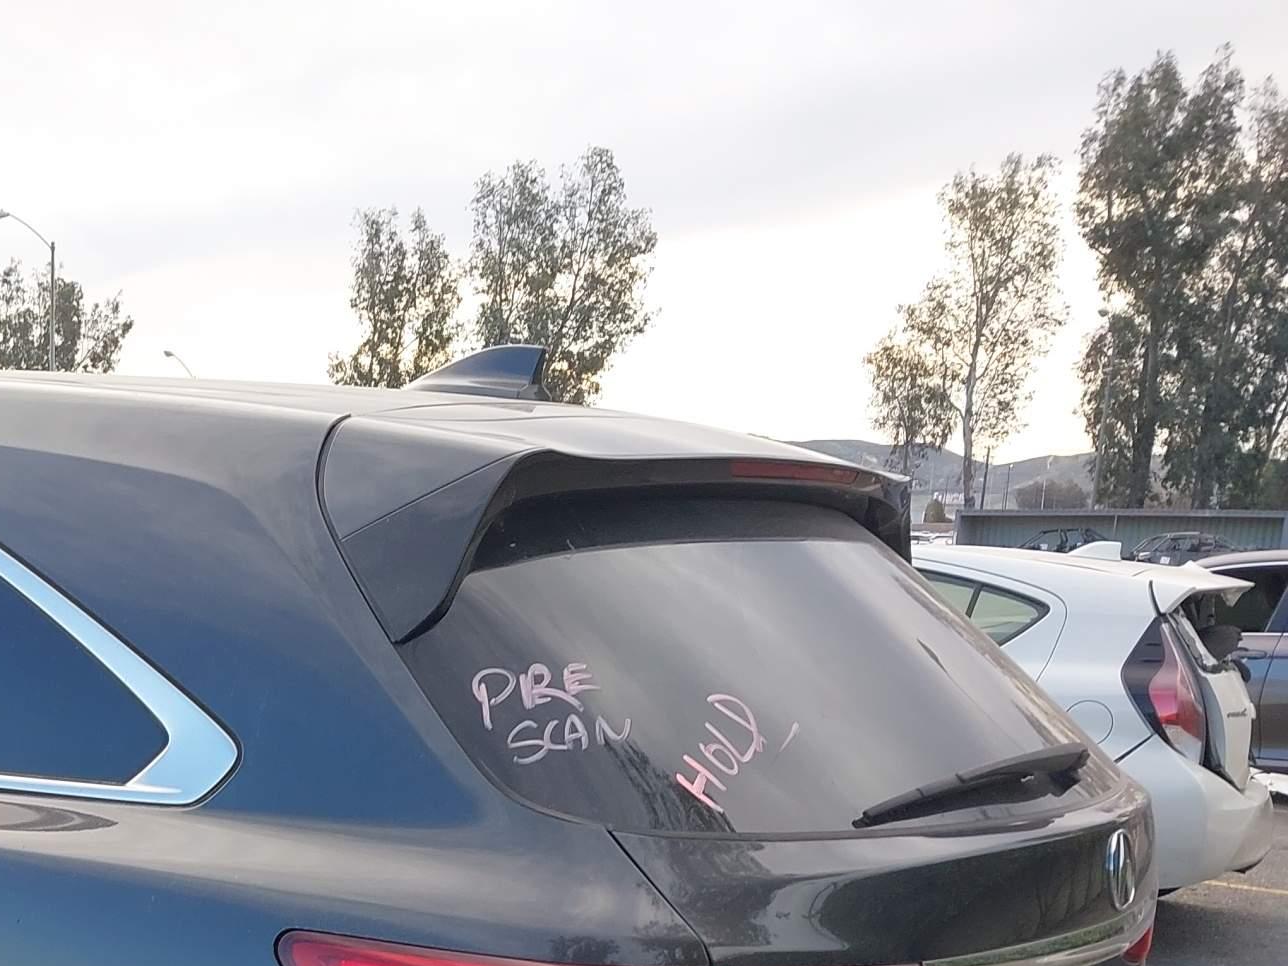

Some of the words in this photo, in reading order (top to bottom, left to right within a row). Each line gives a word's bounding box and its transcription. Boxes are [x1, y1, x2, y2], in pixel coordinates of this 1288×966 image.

[471, 662, 601, 731] PRE
[507, 713, 632, 766] SCAN
[675, 693, 768, 812] HOLD
